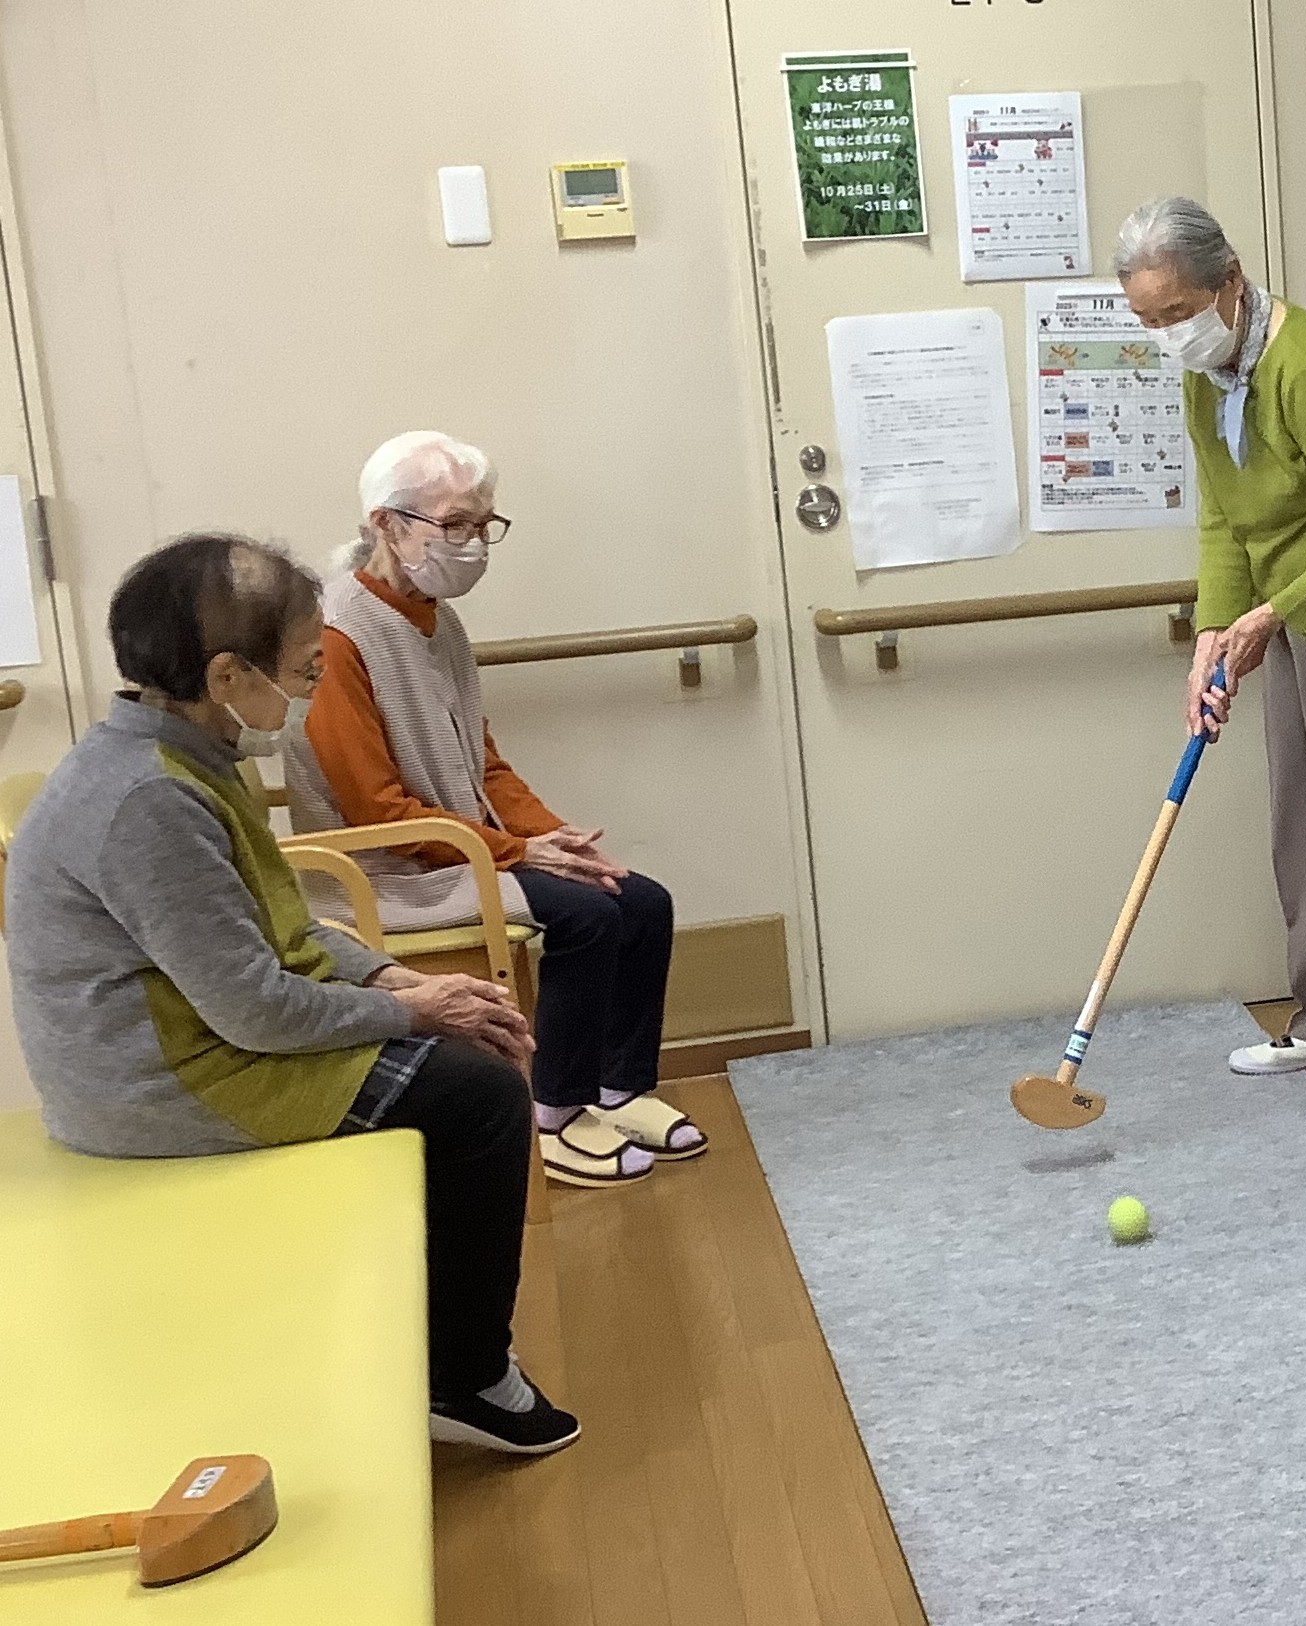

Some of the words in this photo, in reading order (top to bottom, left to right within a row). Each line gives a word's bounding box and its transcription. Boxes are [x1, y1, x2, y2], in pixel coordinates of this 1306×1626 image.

[817, 73, 882, 93] よもぎ湯
[1093, 300, 1114, 310] 11月
